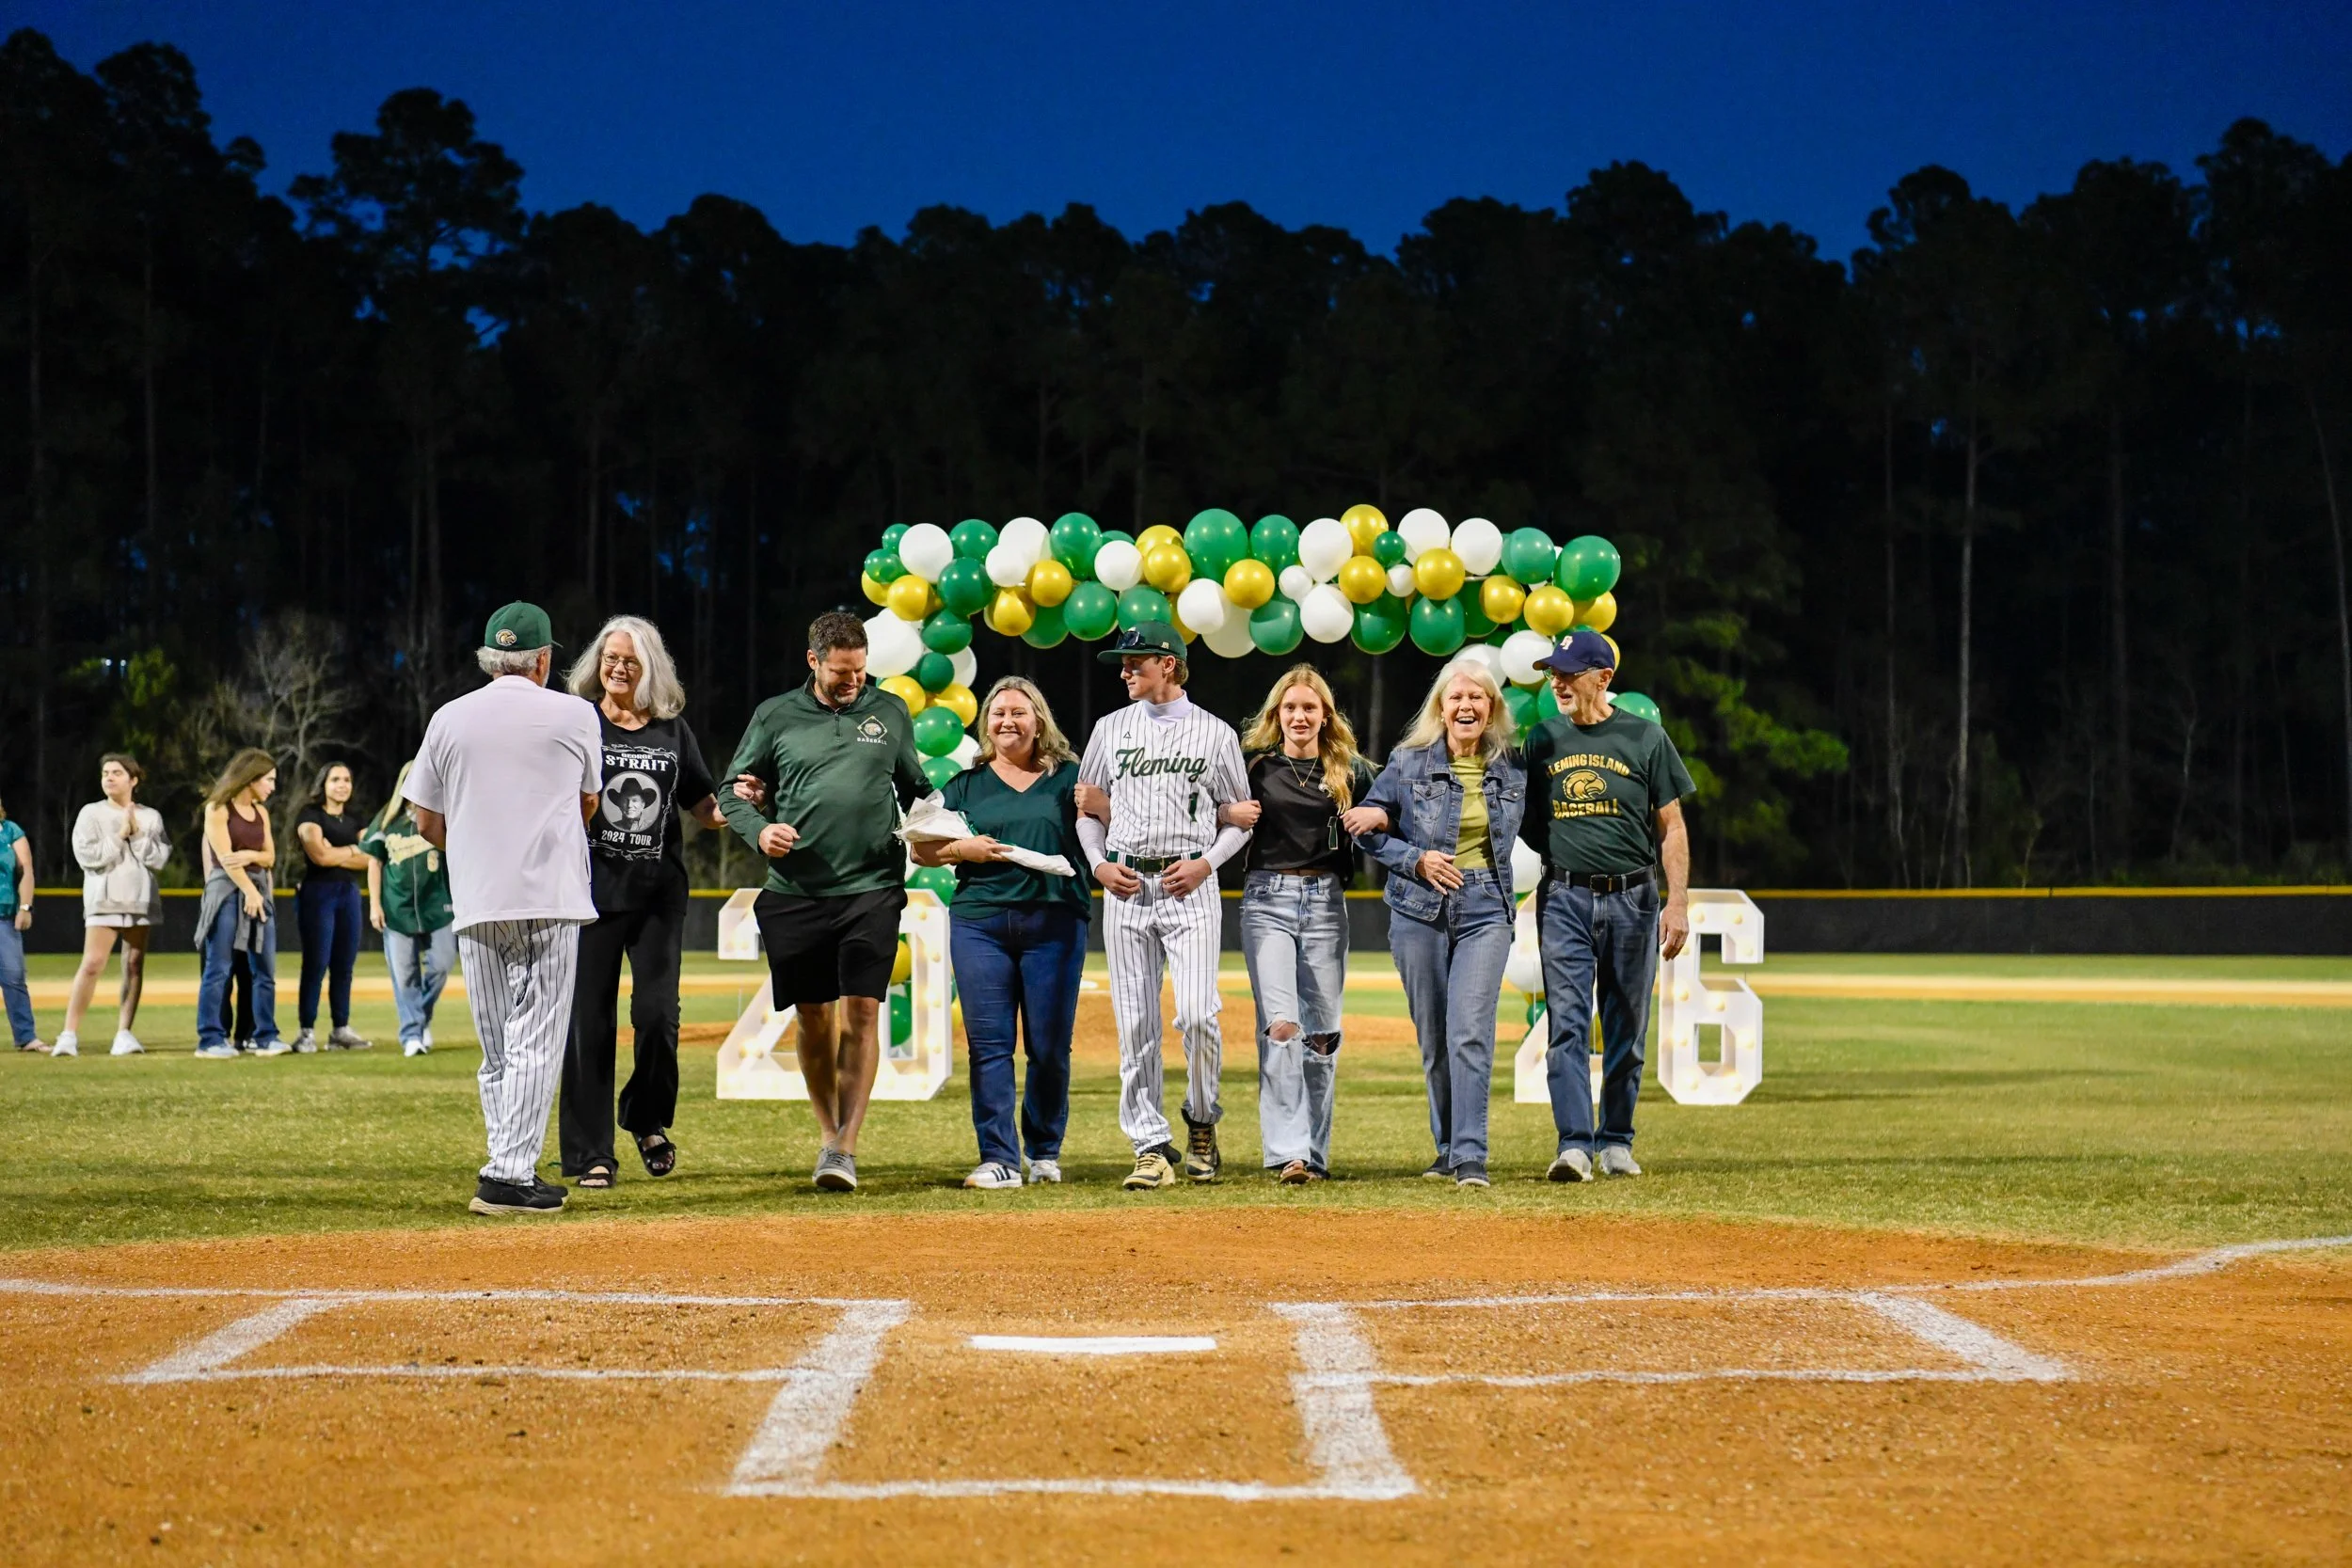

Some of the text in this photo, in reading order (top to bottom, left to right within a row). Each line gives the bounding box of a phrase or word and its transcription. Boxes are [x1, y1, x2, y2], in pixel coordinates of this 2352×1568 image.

[856, 736, 887, 745] BASEBALL
[605, 754, 669, 771] STRAIT
[1116, 747, 1207, 783] Fleming
[1588, 753, 1630, 776] ISLAND
[1188, 792, 1200, 822] 1
[601, 830, 652, 846] 2024 TOUR
[1327, 816, 1338, 850] 1
